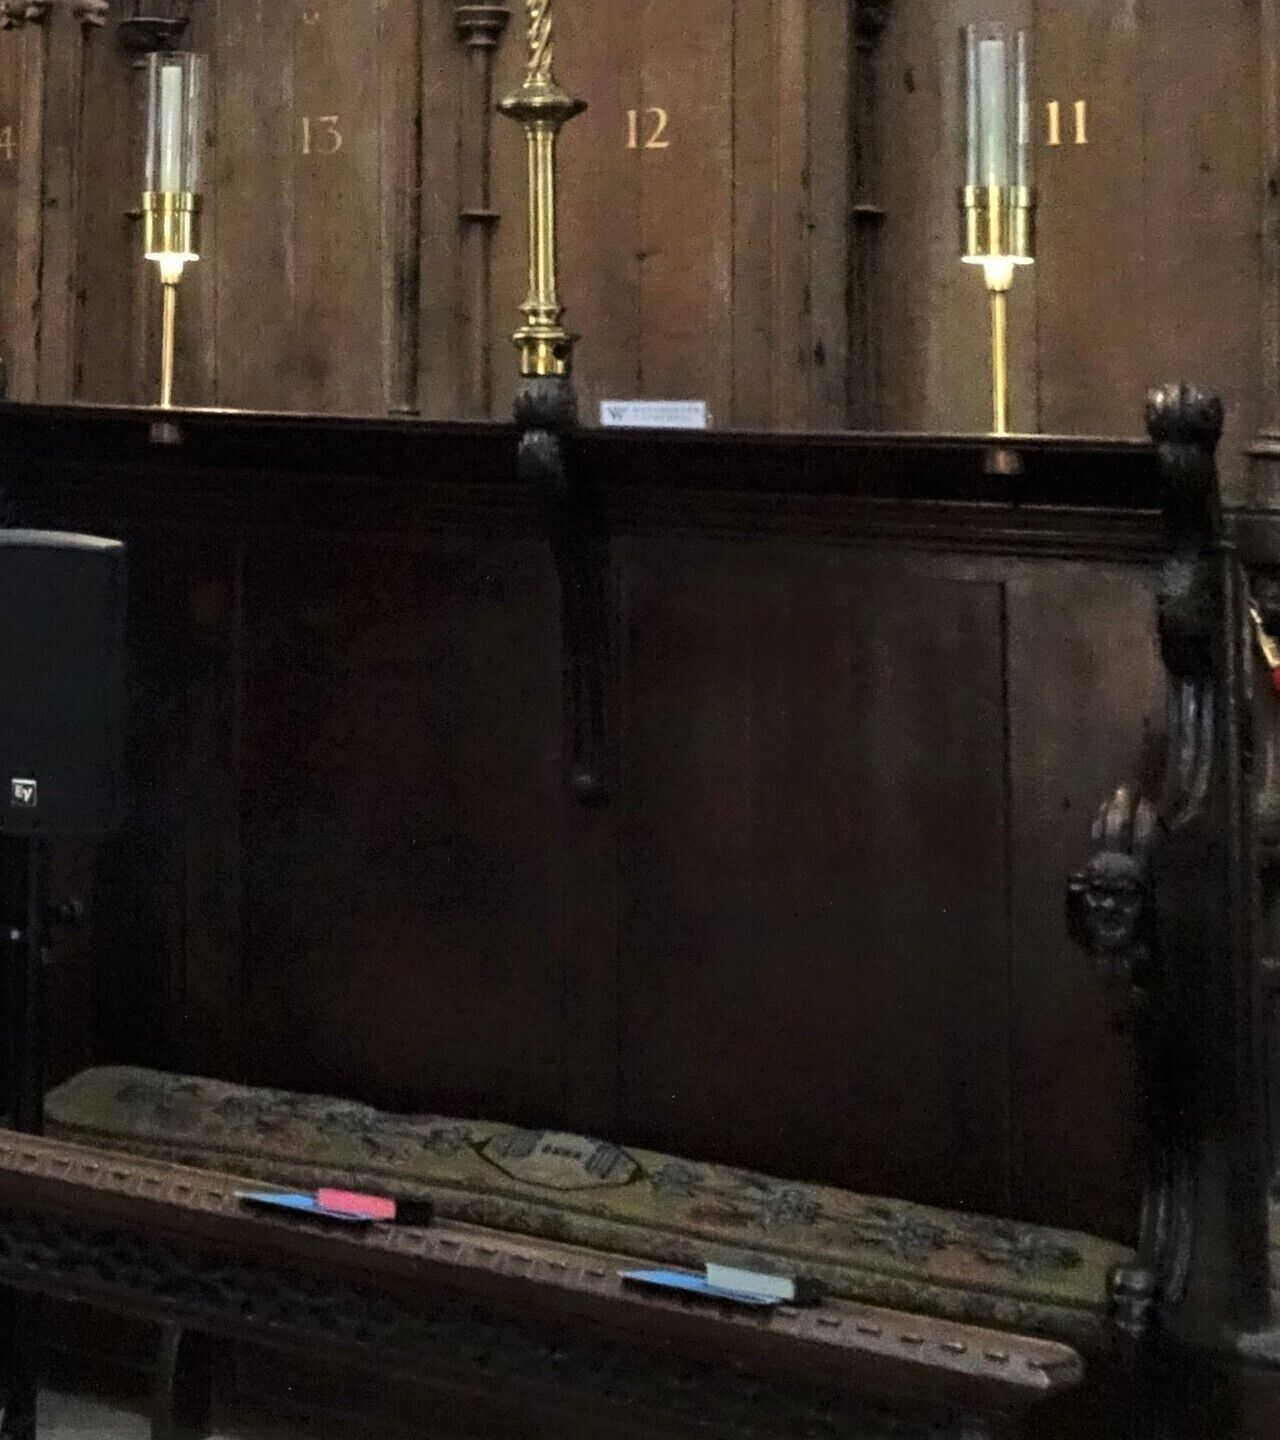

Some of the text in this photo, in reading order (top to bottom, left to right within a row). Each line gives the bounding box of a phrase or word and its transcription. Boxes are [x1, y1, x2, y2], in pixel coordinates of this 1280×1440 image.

[302, 116, 342, 154] 13
[627, 107, 670, 148] 12
[1046, 99, 1088, 145] 11
